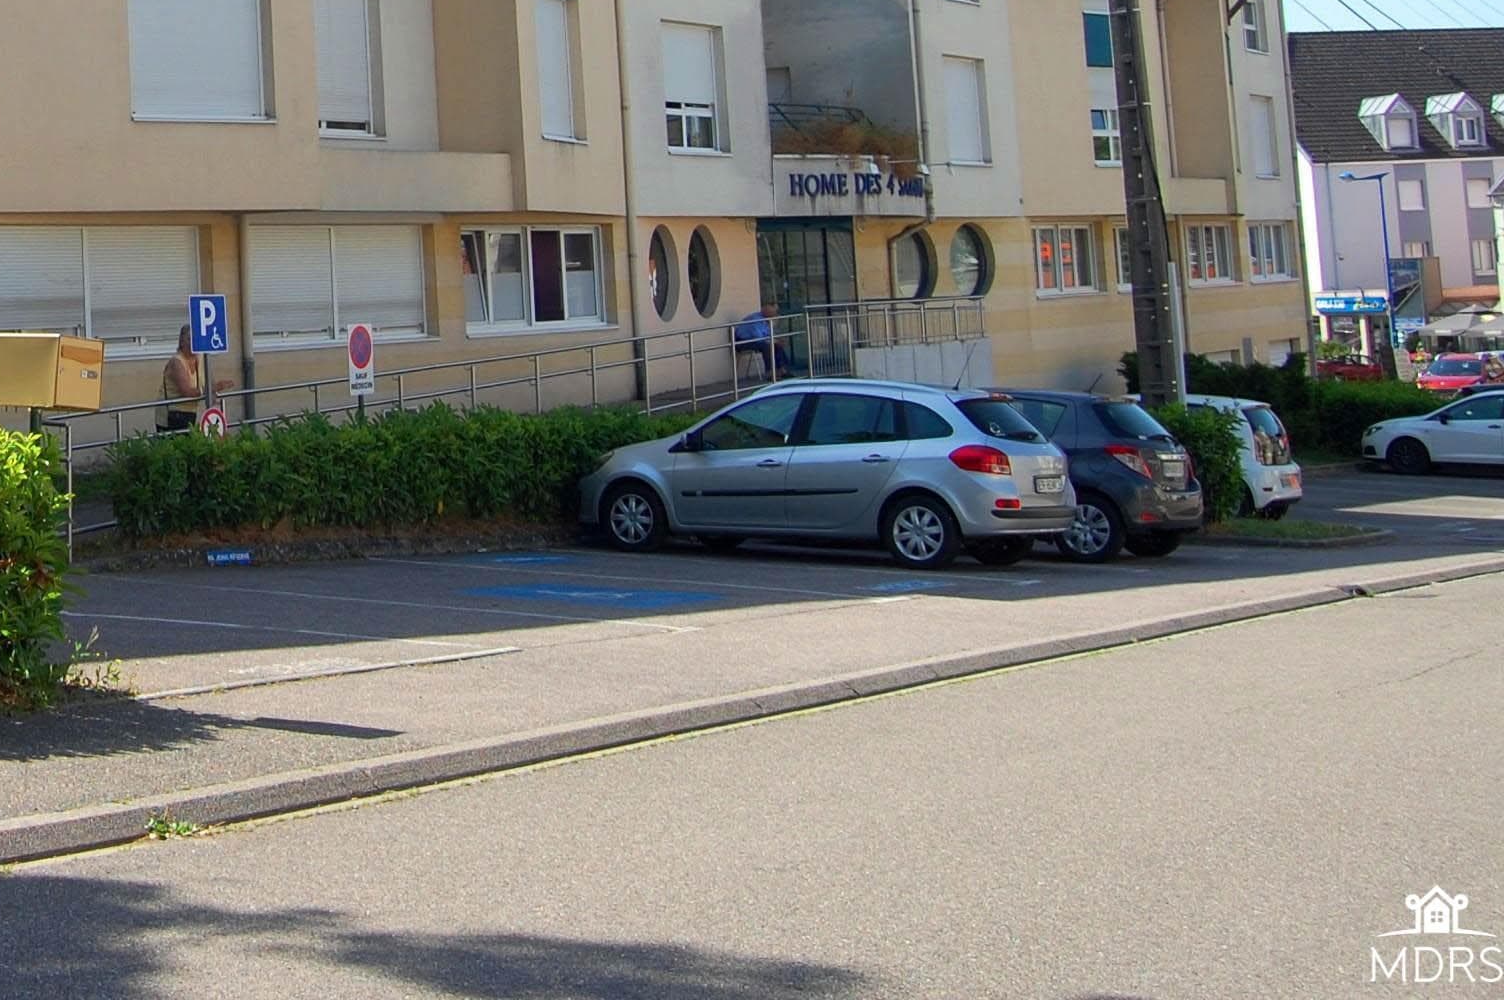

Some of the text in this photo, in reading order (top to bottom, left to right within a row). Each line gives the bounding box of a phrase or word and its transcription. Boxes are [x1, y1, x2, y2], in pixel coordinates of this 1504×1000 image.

[789, 173, 849, 197] HOME
[854, 173, 882, 196] DES
[200, 299, 216, 337] P
